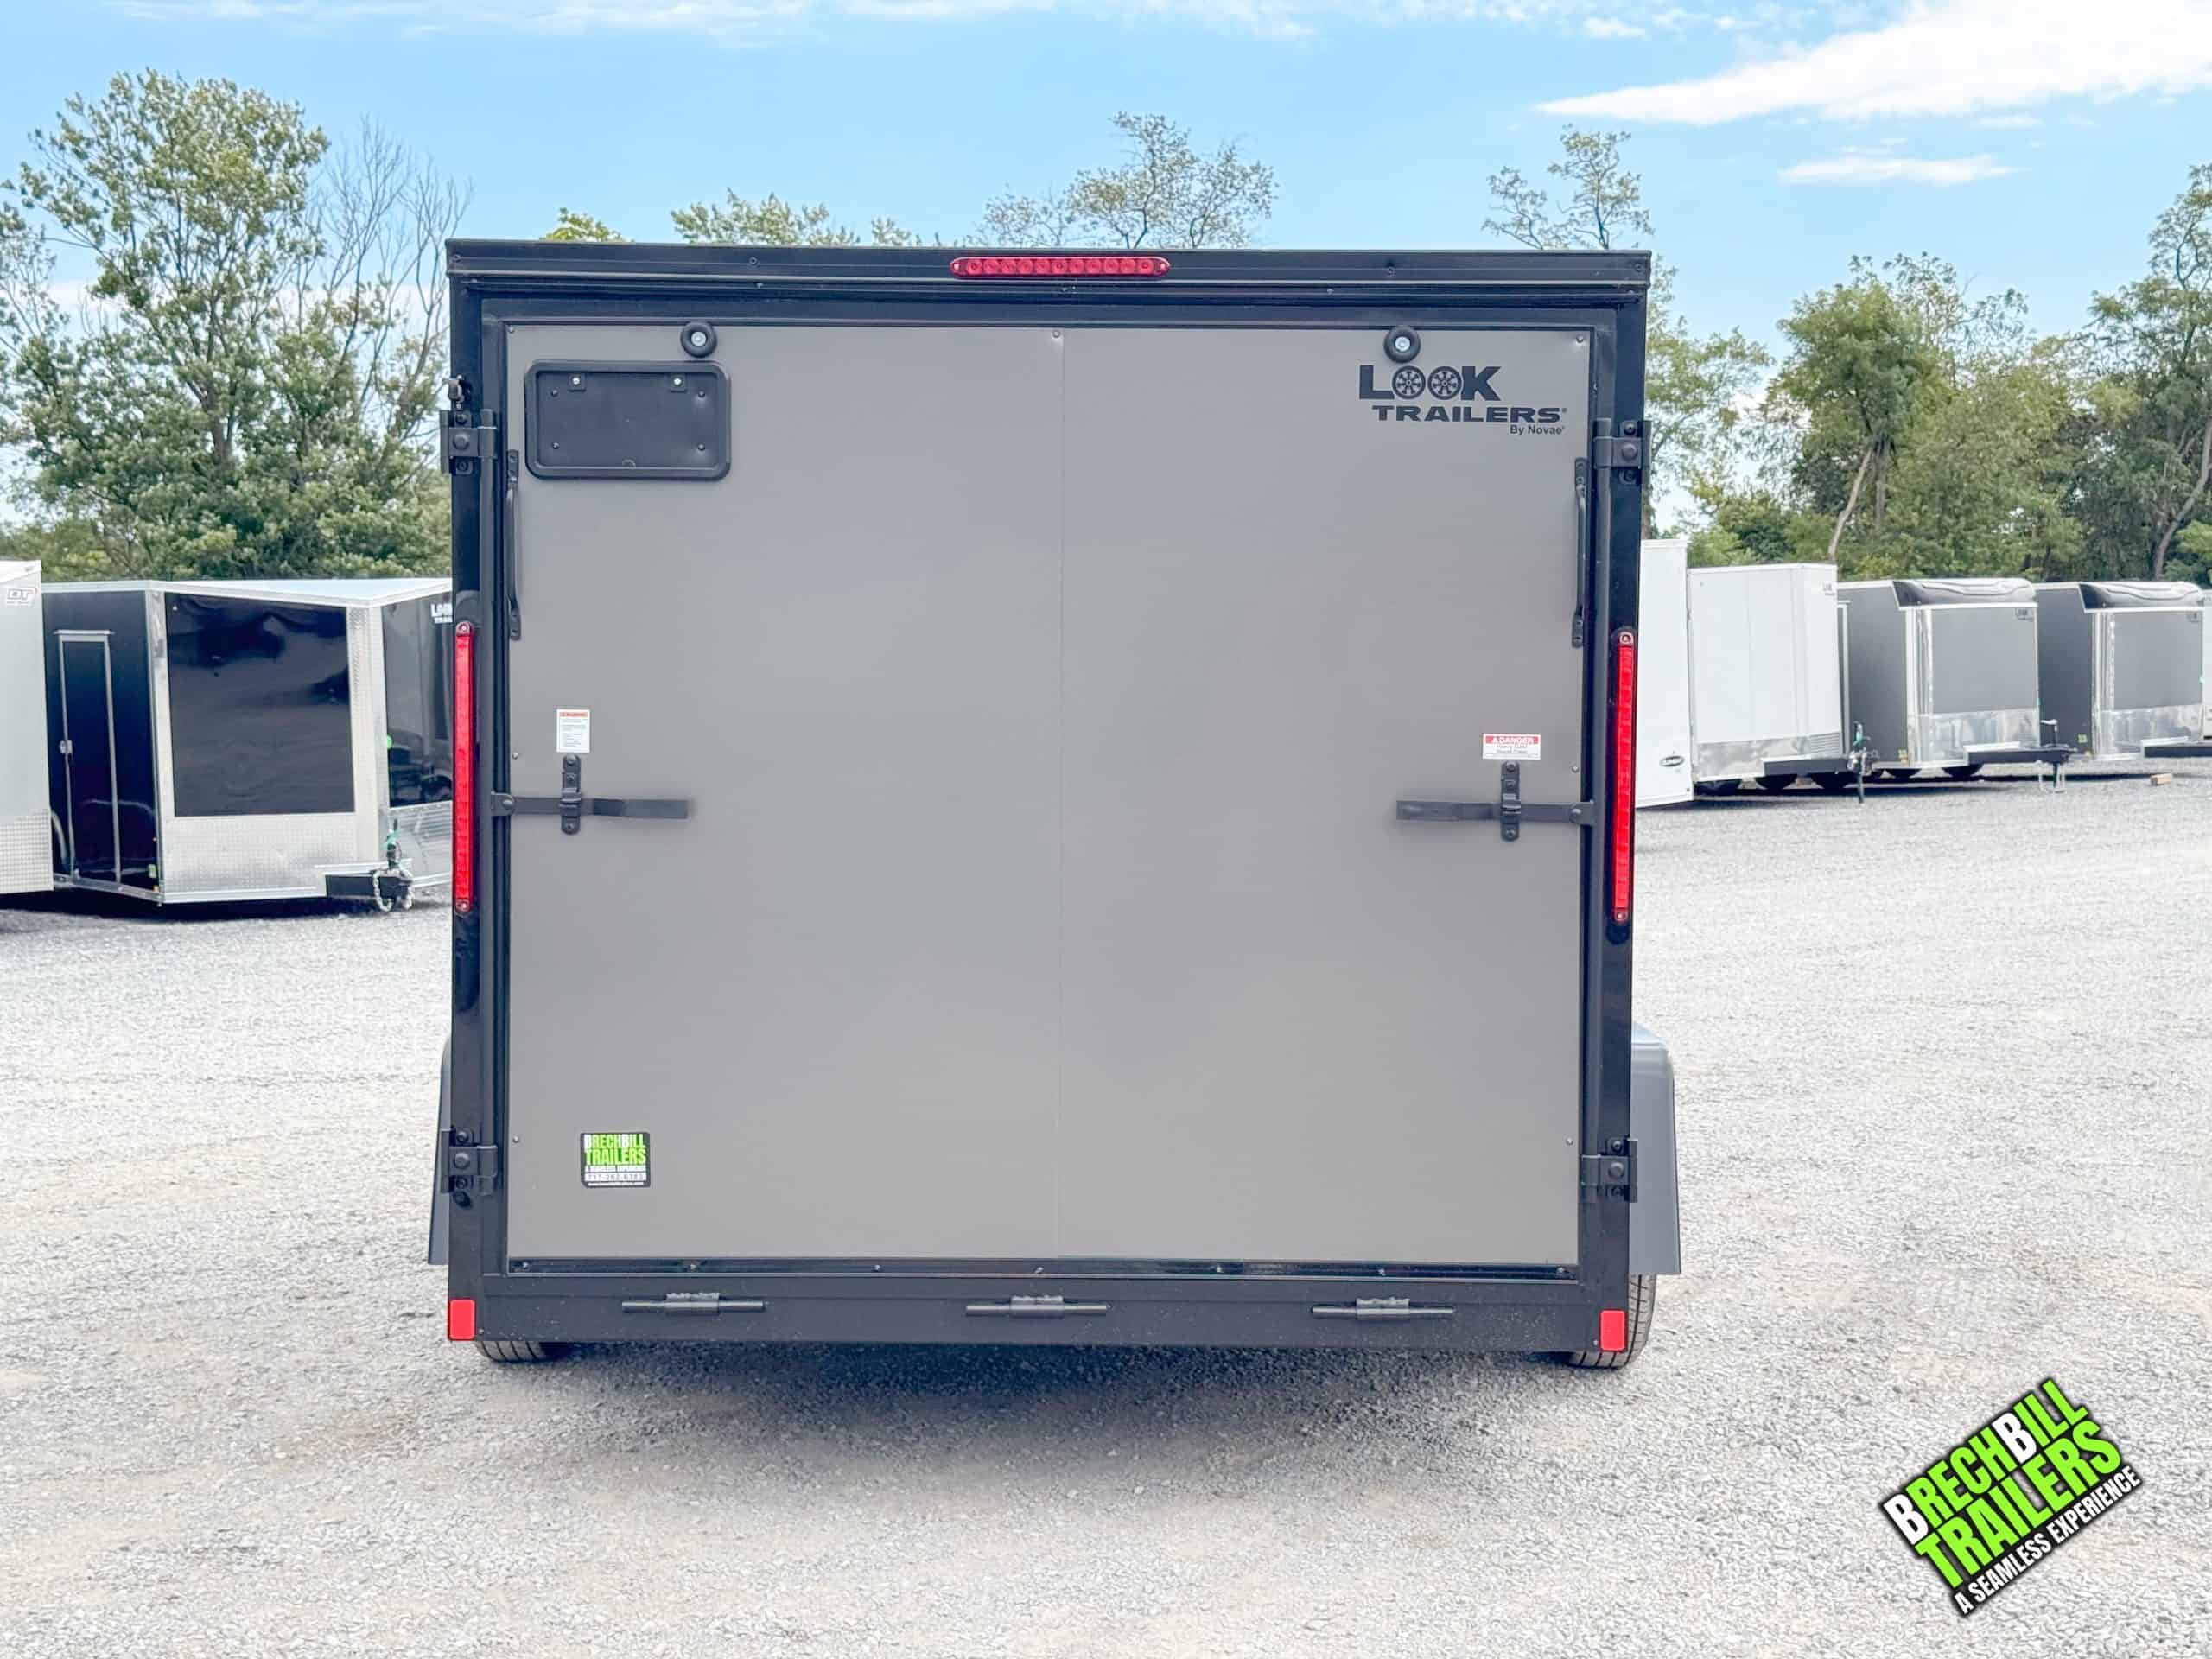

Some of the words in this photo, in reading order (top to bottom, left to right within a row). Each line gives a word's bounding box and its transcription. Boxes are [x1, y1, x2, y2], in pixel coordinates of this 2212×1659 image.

[1359, 365, 1502, 401] LOOK
[1372, 404, 1561, 423] TRAILERS
[1510, 424, 1525, 435] By
[584, 1133, 646, 1149] BRECHBILL
[586, 1147, 647, 1165] TRAILERS
